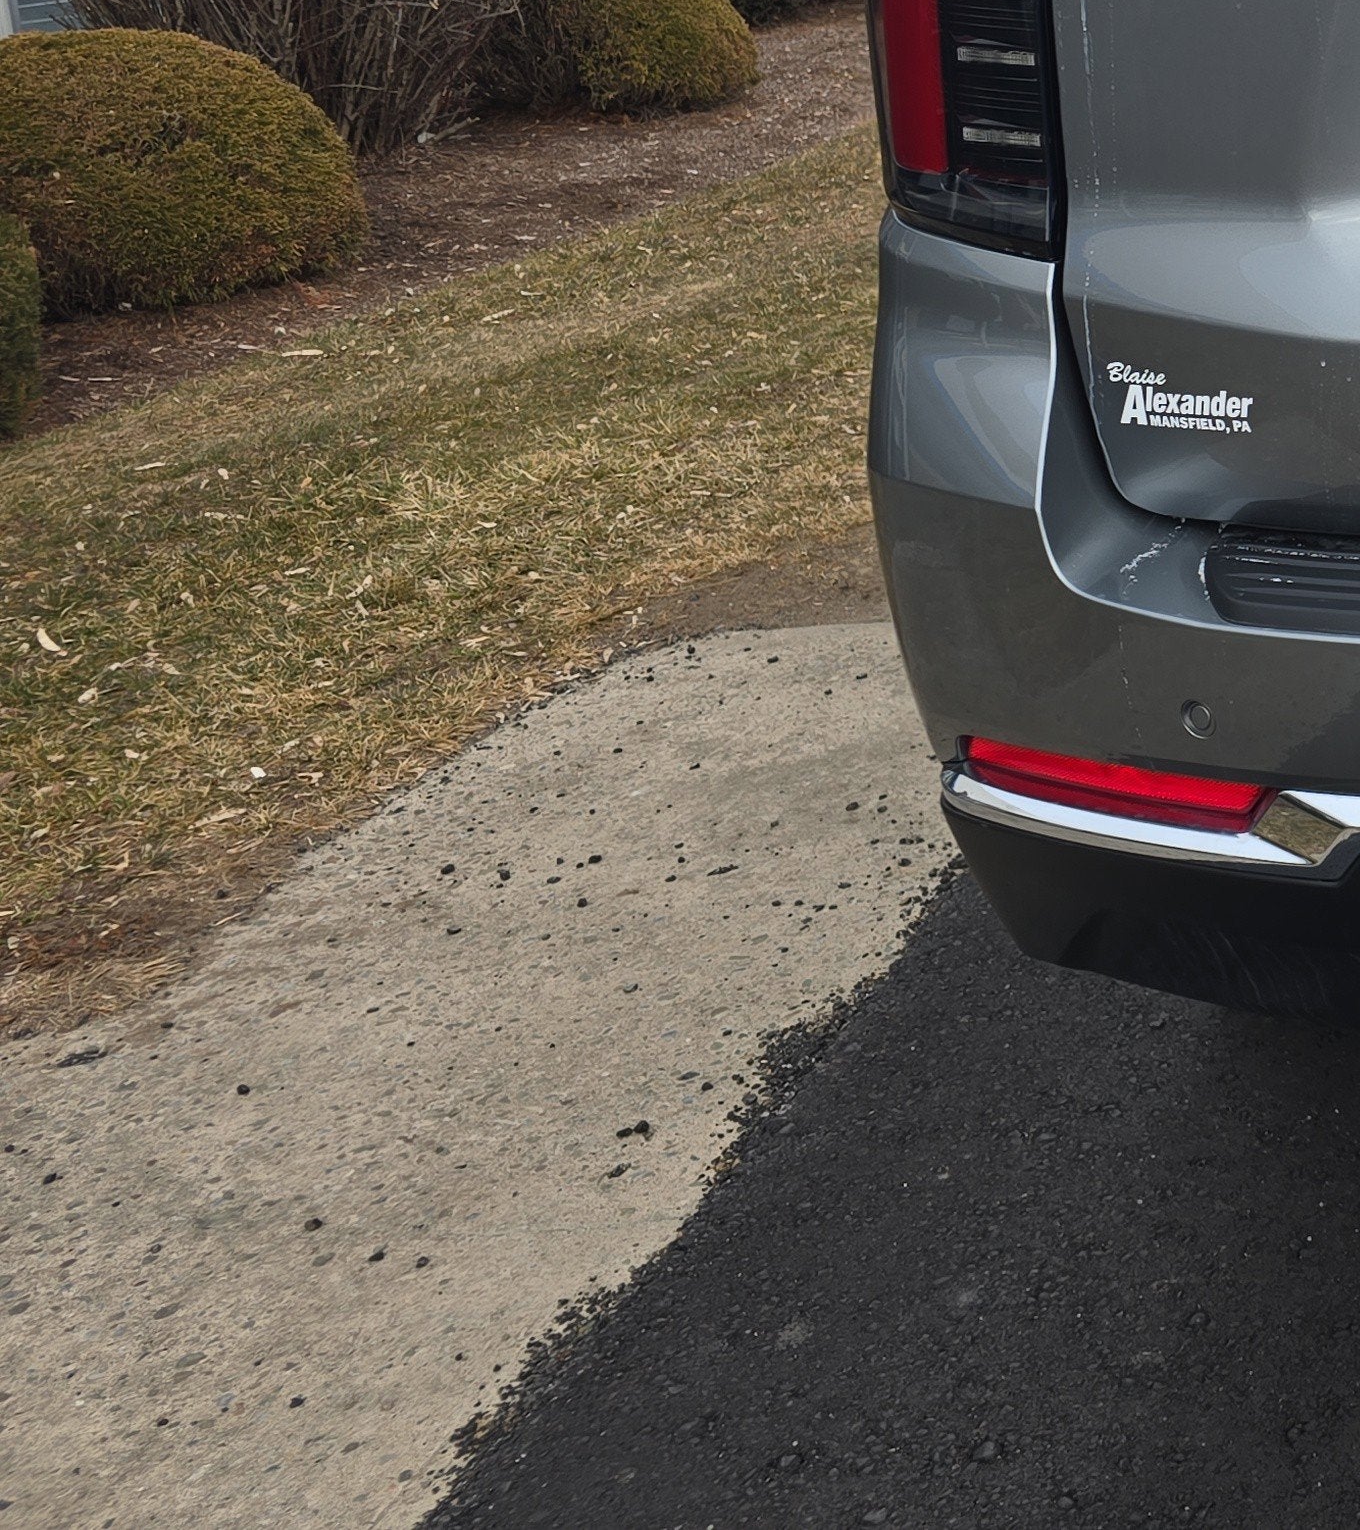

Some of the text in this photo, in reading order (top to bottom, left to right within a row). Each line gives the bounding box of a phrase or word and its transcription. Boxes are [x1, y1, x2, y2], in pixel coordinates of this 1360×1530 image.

[1106, 361, 1167, 386] Blaise
[1120, 384, 1254, 426] Alexander
[1149, 415, 1252, 434] MANSFIELD, PA
